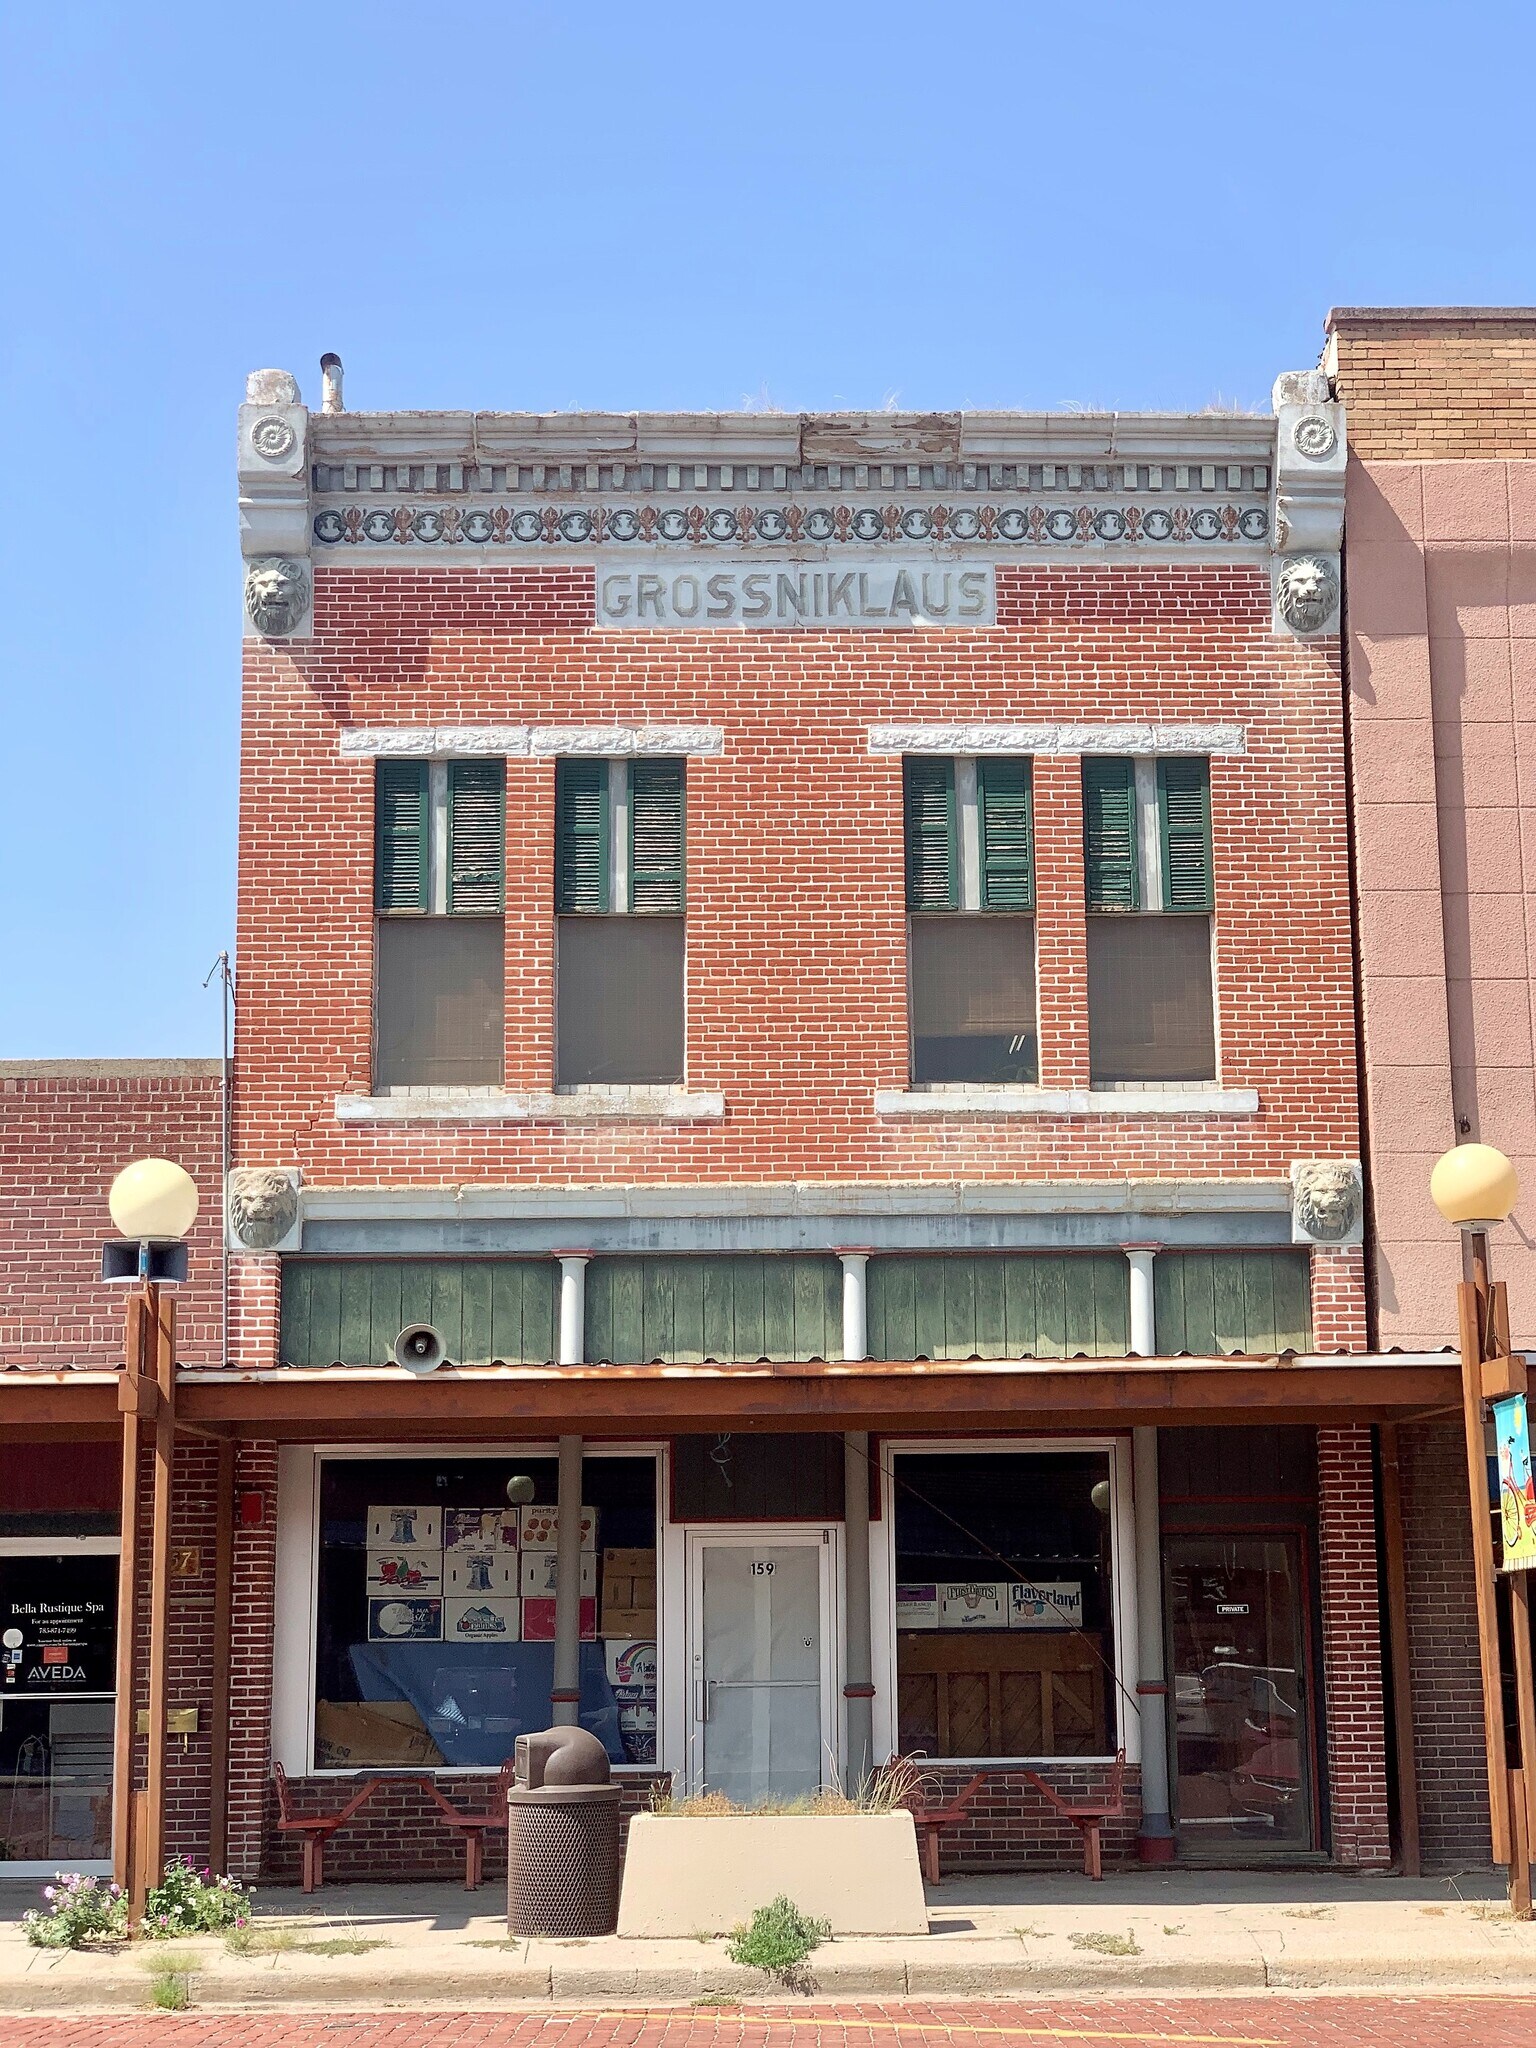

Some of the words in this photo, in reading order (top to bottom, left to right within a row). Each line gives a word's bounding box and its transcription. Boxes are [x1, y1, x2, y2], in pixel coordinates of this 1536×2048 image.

[602, 569, 988, 618] GROSSNIKLAUS
[751, 1562, 775, 1575] 159
[11, 1603, 37, 1614] Bella
[40, 1602, 83, 1615] Rustique
[85, 1601, 104, 1614] Spa
[27, 1666, 87, 1679] AVEDA
